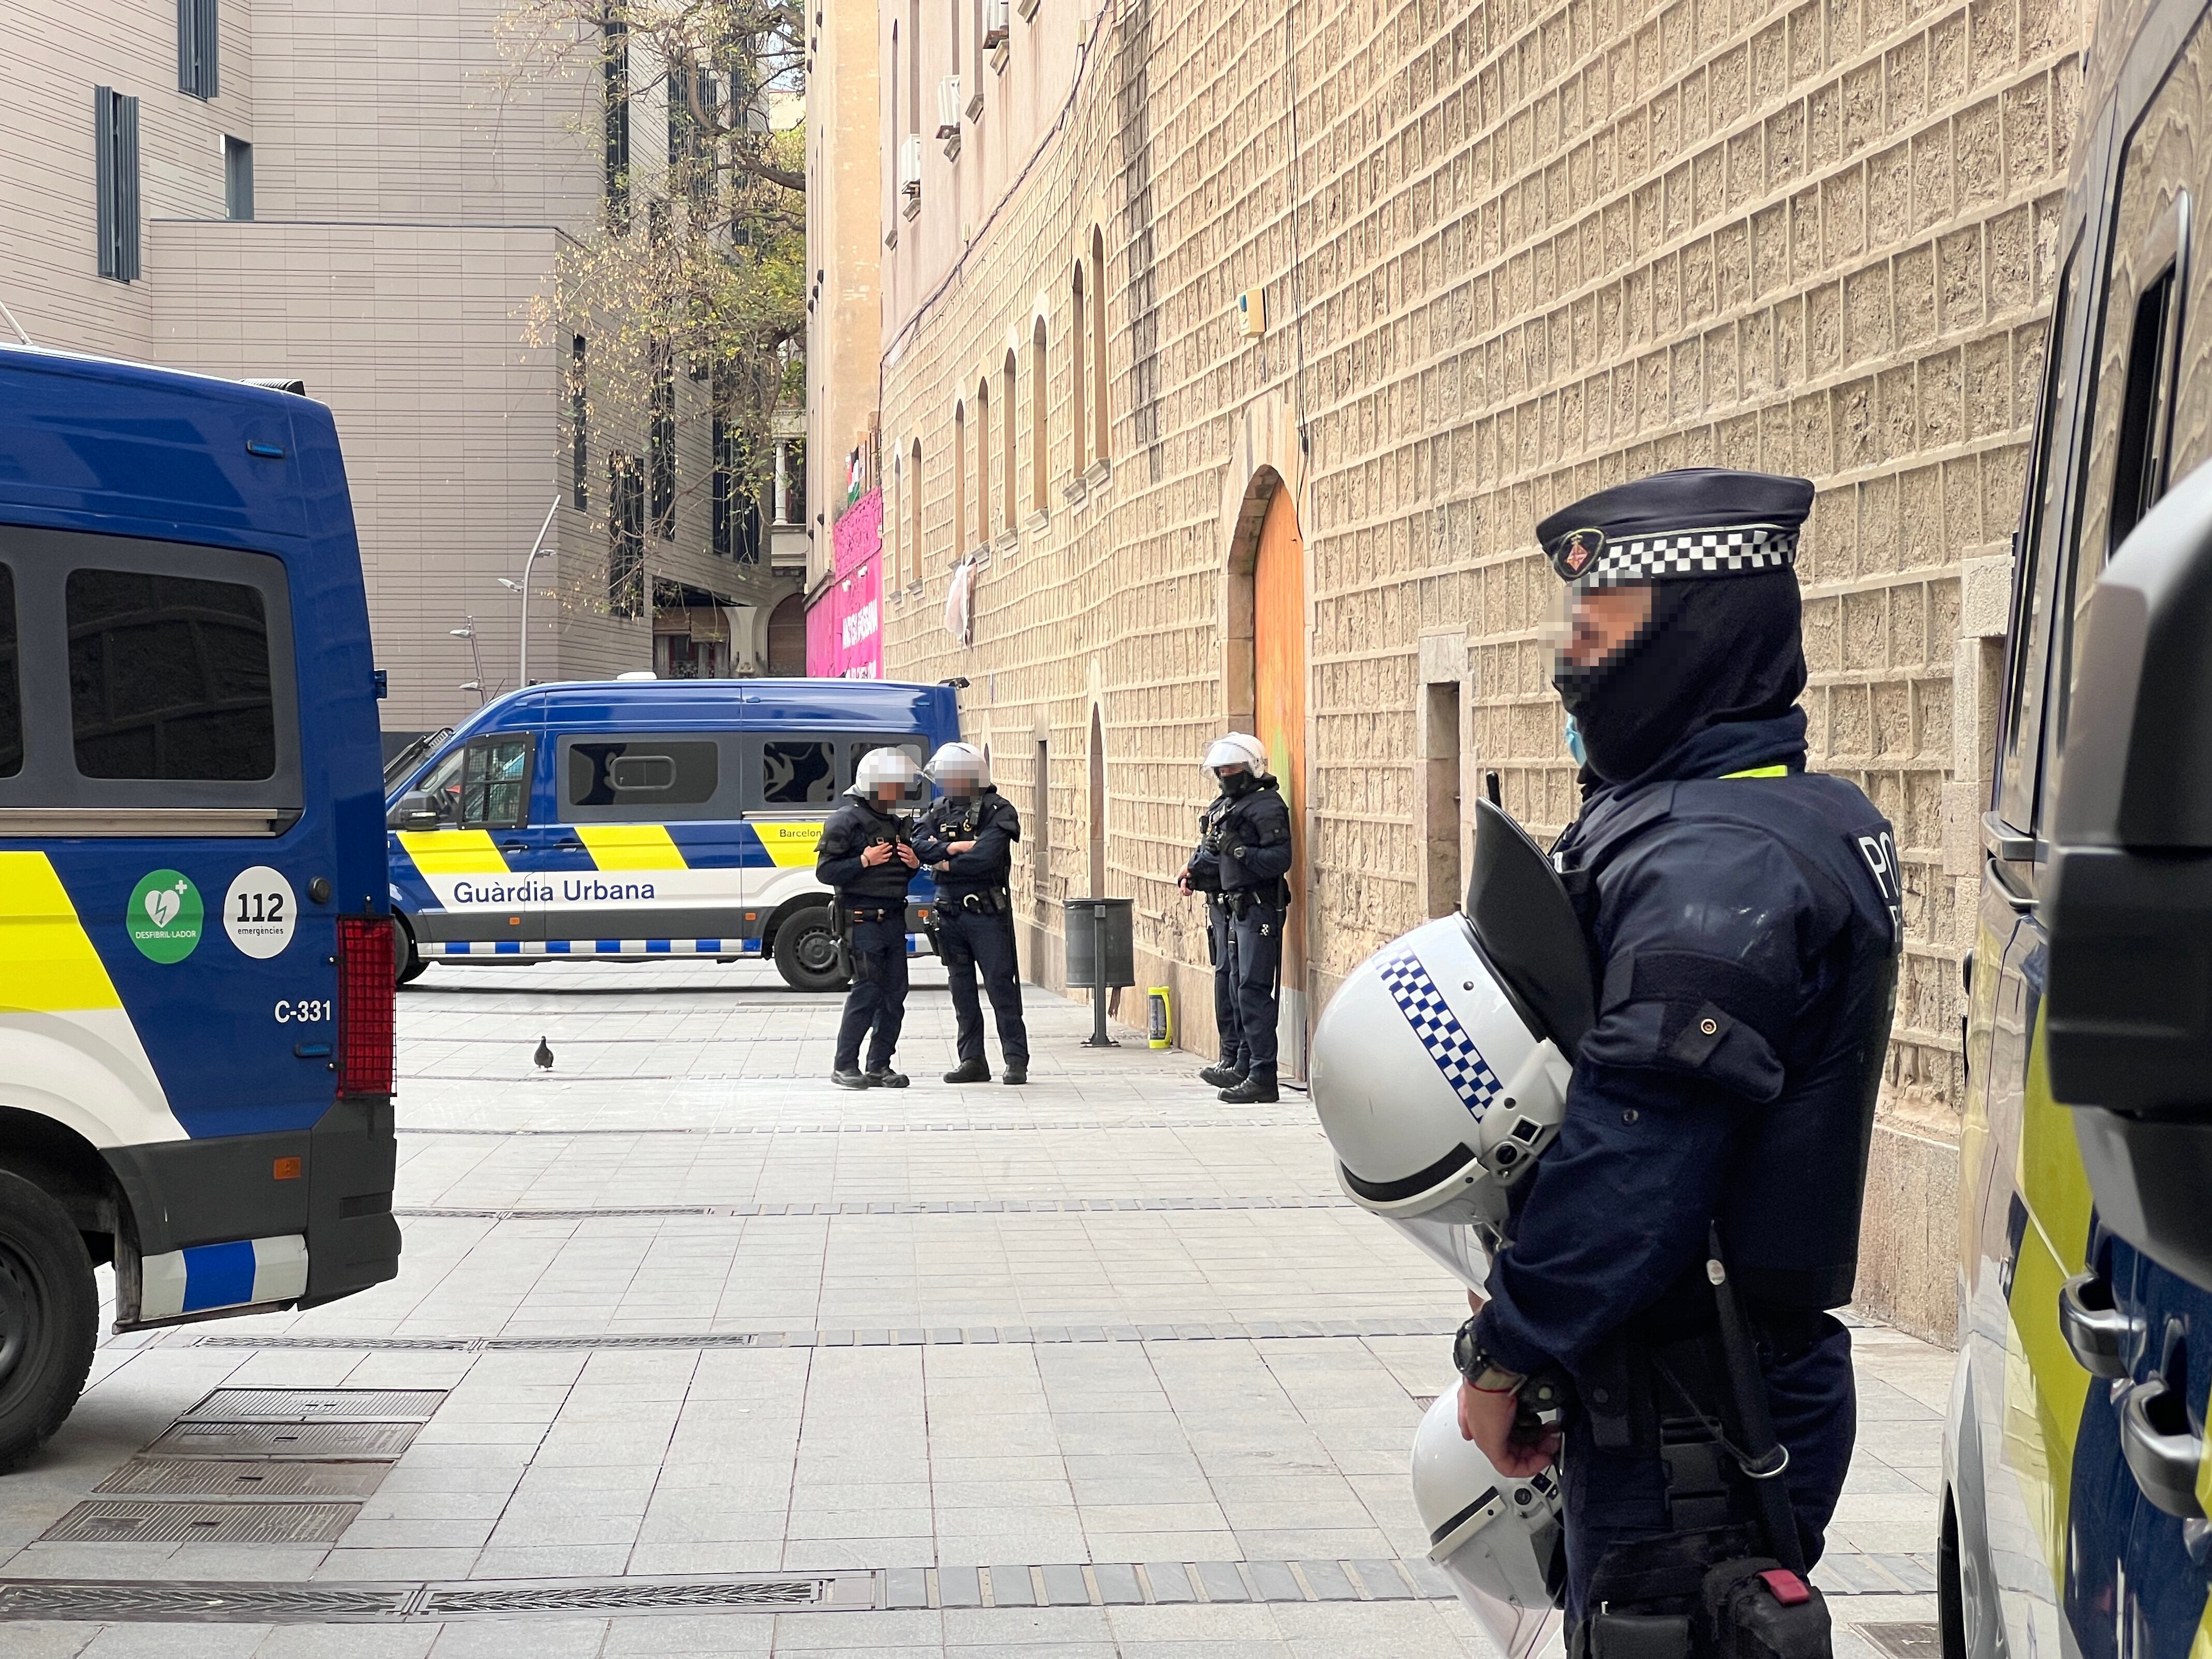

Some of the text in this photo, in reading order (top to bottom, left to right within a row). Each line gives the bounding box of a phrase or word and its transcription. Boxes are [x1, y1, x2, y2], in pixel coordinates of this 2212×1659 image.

[454, 880, 655, 903] Guàrdia Urbana
[237, 893, 284, 922] 112
[237, 926, 284, 936] emergències
[274, 1000, 330, 1023] C-331
